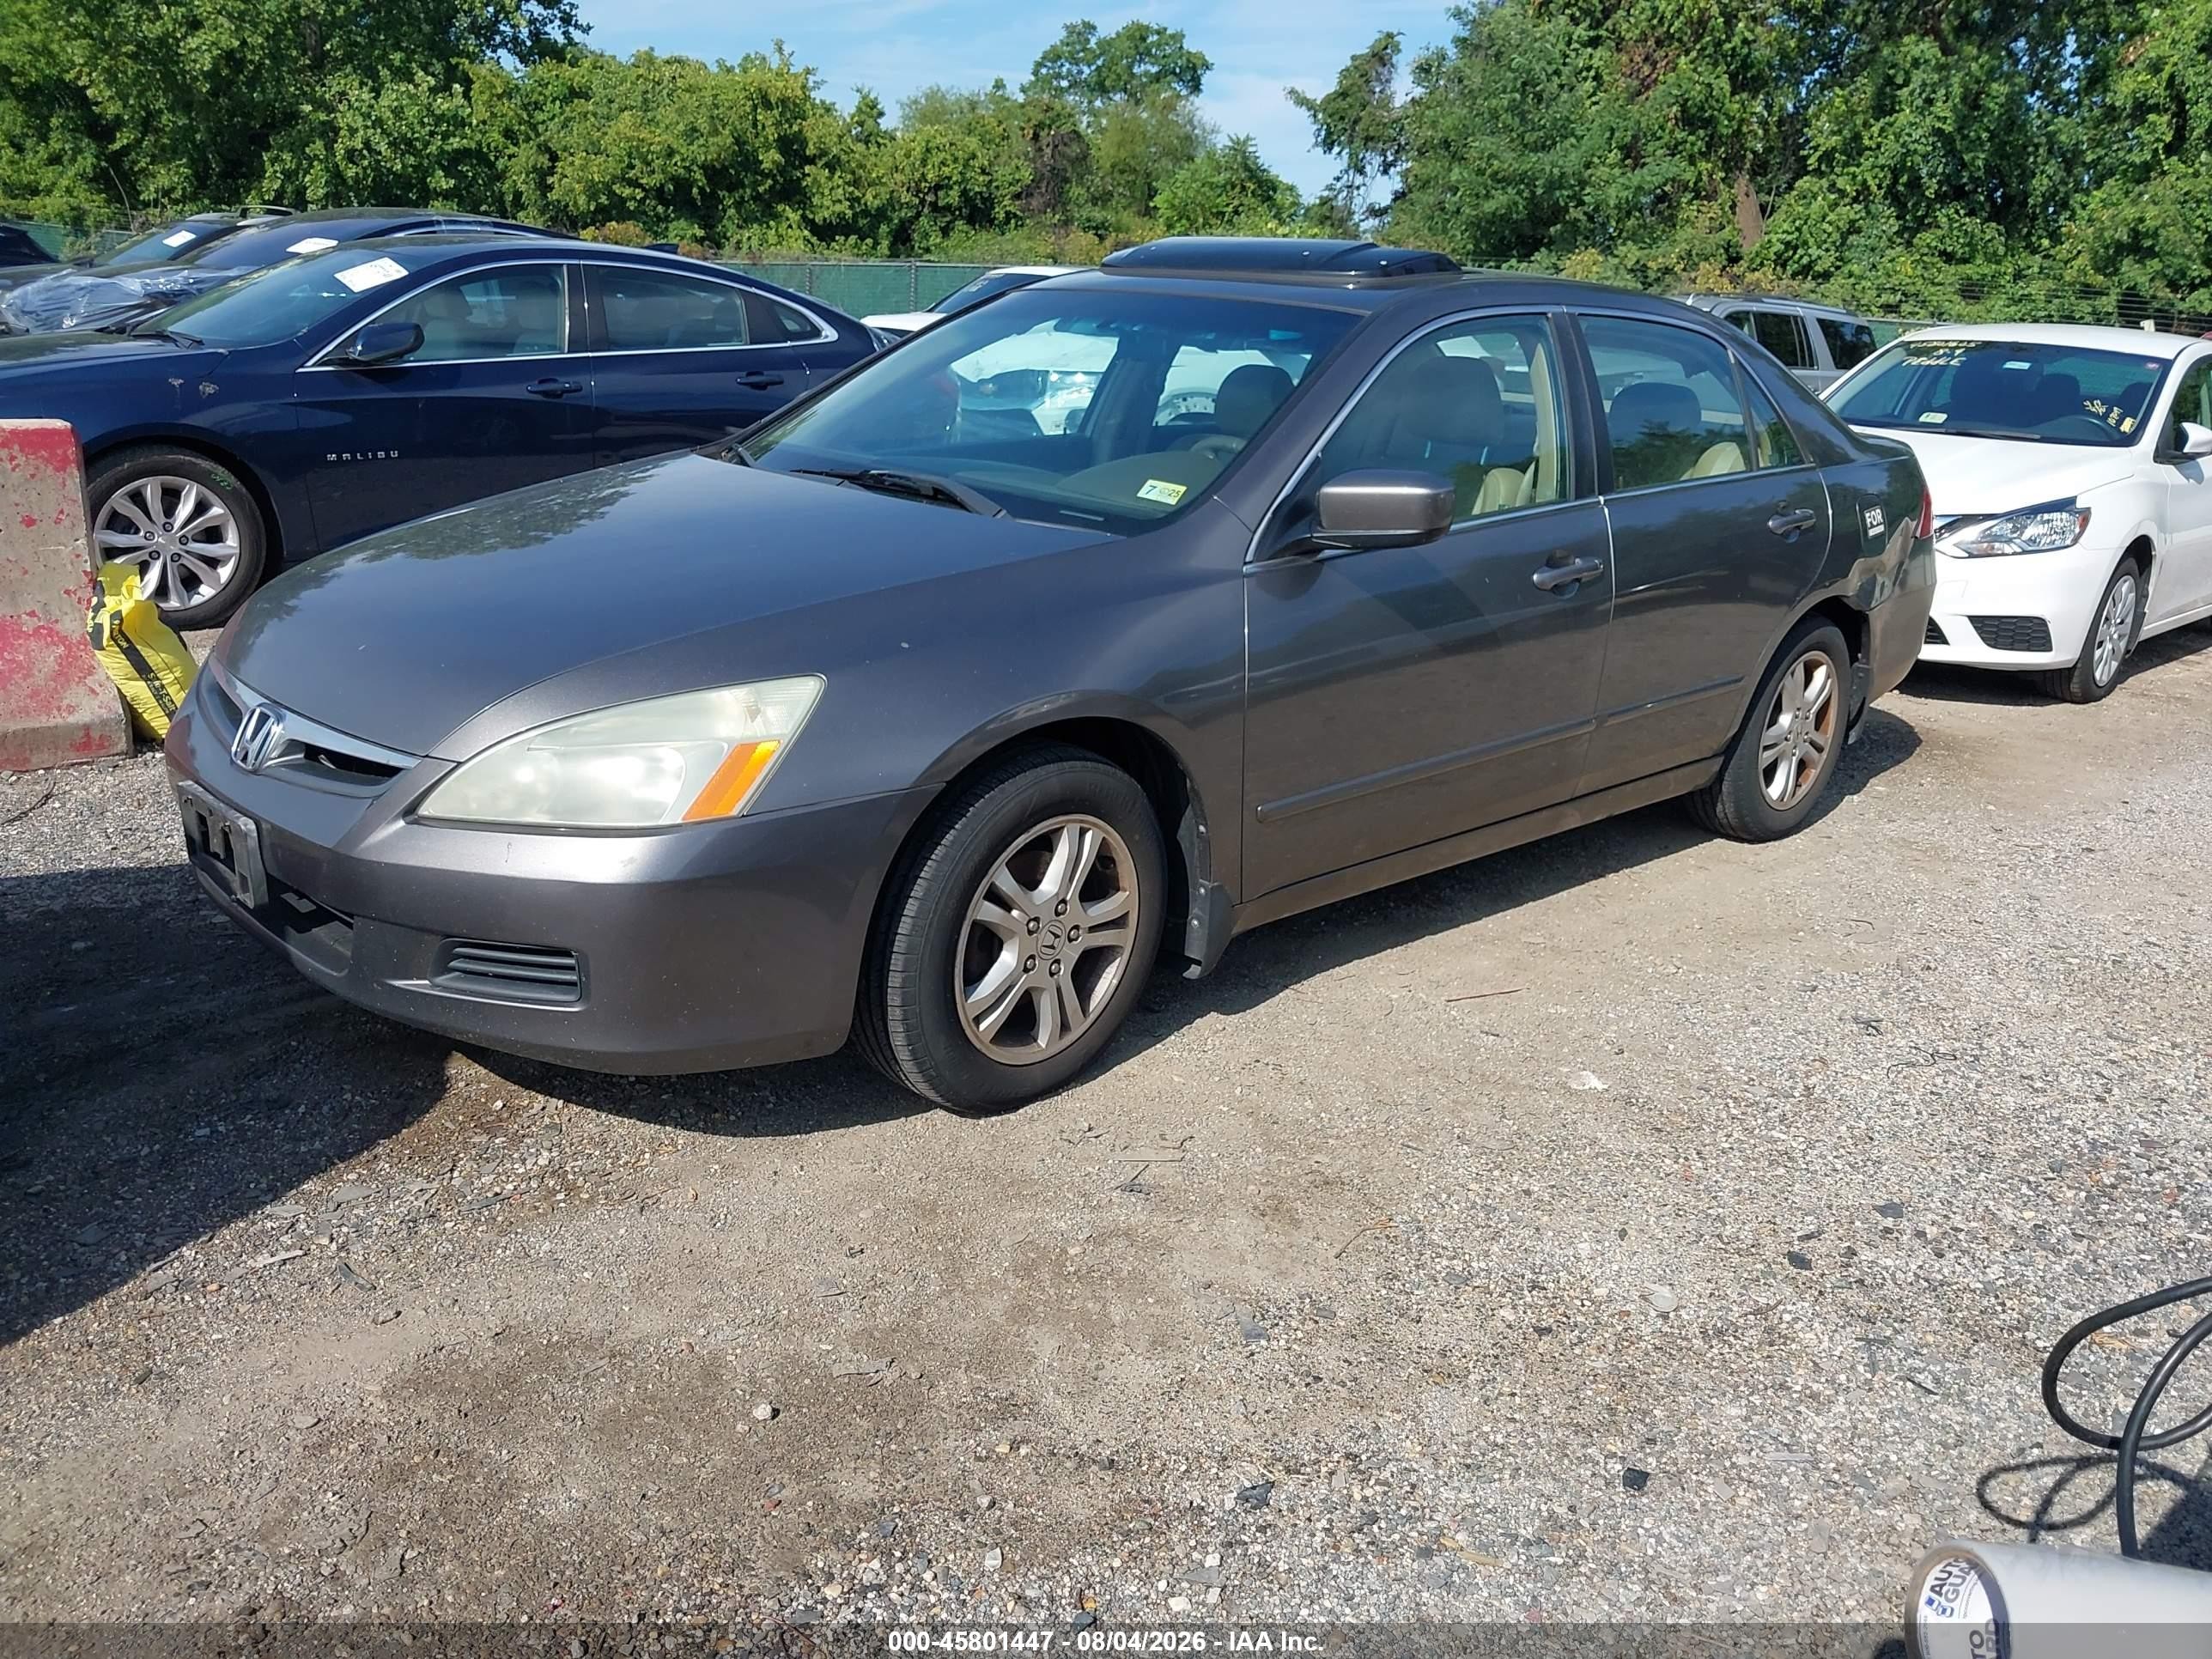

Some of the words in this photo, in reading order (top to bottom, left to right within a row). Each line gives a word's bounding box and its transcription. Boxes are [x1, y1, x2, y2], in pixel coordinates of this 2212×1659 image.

[326, 450, 398, 461] MALIBU
[1145, 484, 1158, 495] 7
[1167, 489, 1182, 498] 25
[1865, 508, 1884, 528] FOR
